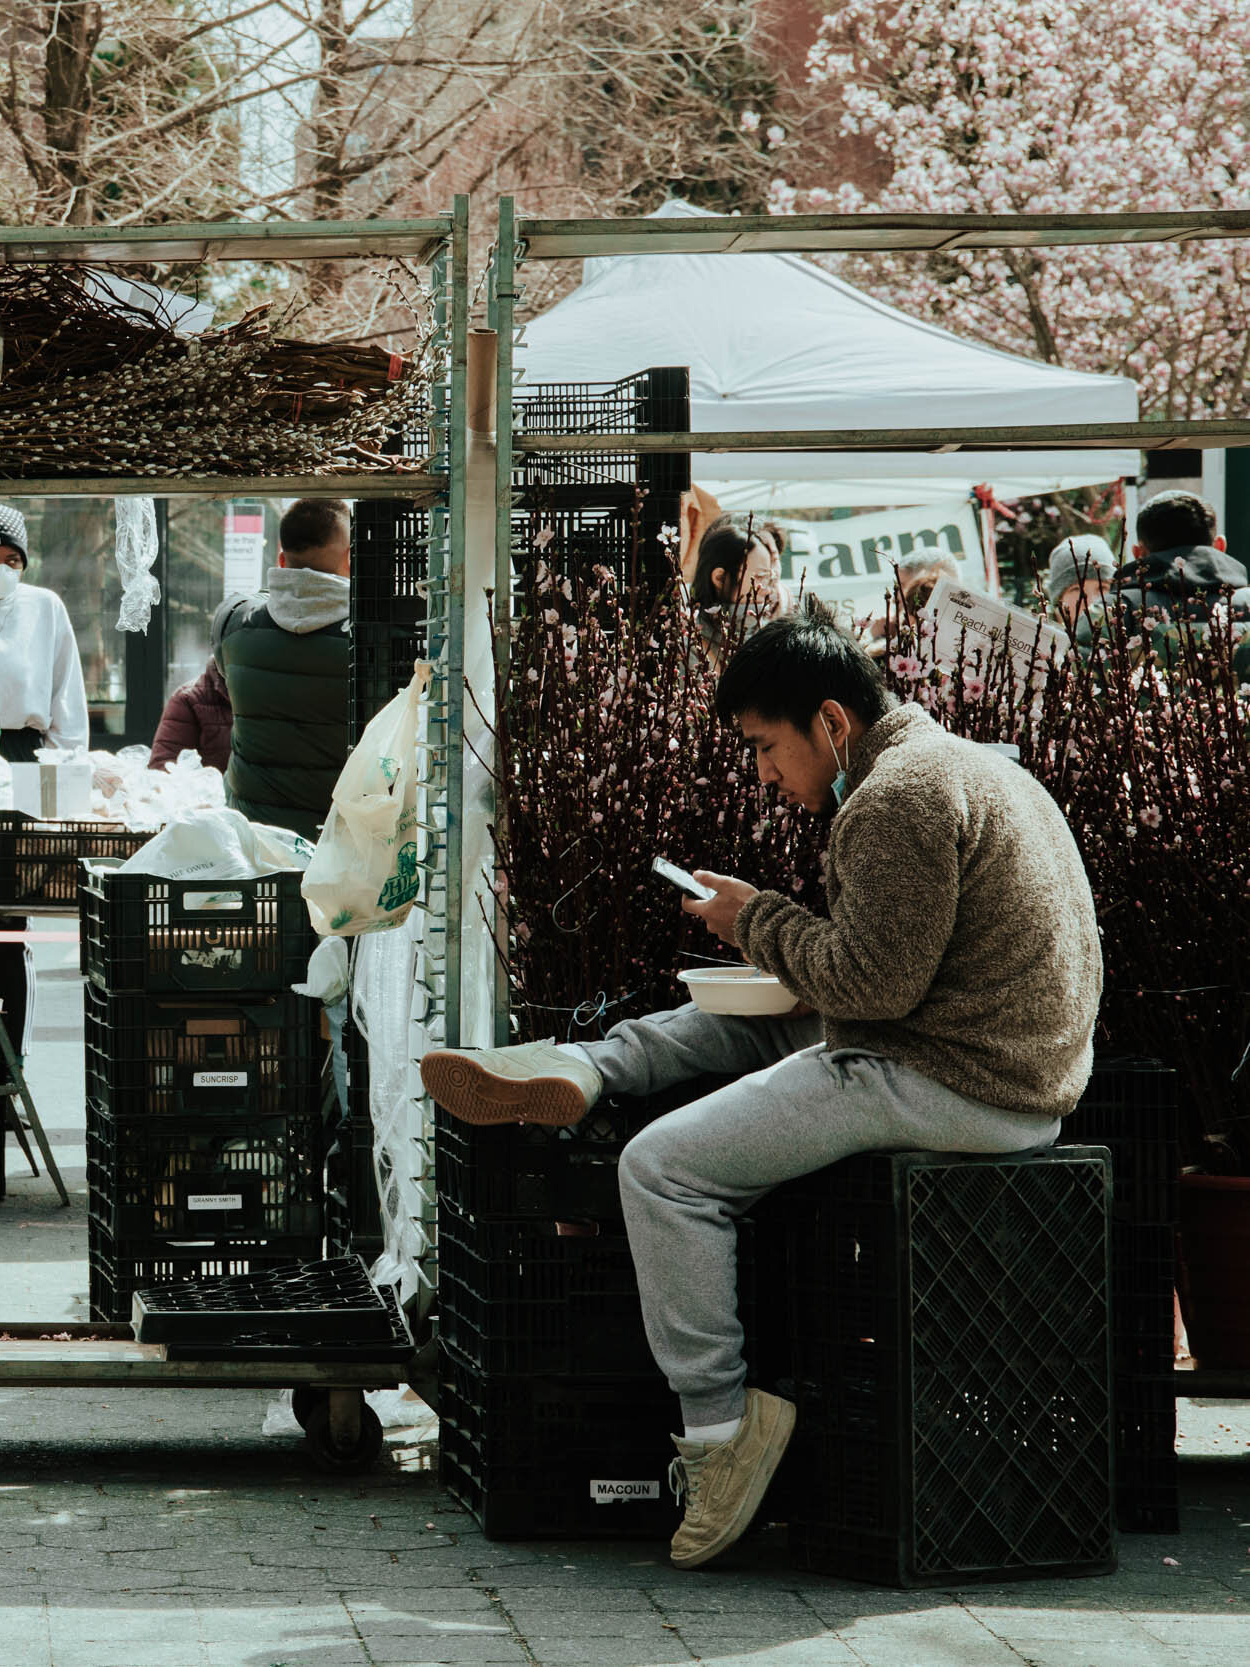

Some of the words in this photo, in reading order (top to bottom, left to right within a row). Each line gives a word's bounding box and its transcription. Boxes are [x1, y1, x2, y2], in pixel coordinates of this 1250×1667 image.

[779, 524, 966, 580] Farm
[954, 610, 987, 633] Peach
[200, 1075, 239, 1083] SUNCRISP
[597, 1484, 650, 1495] MACOUN
